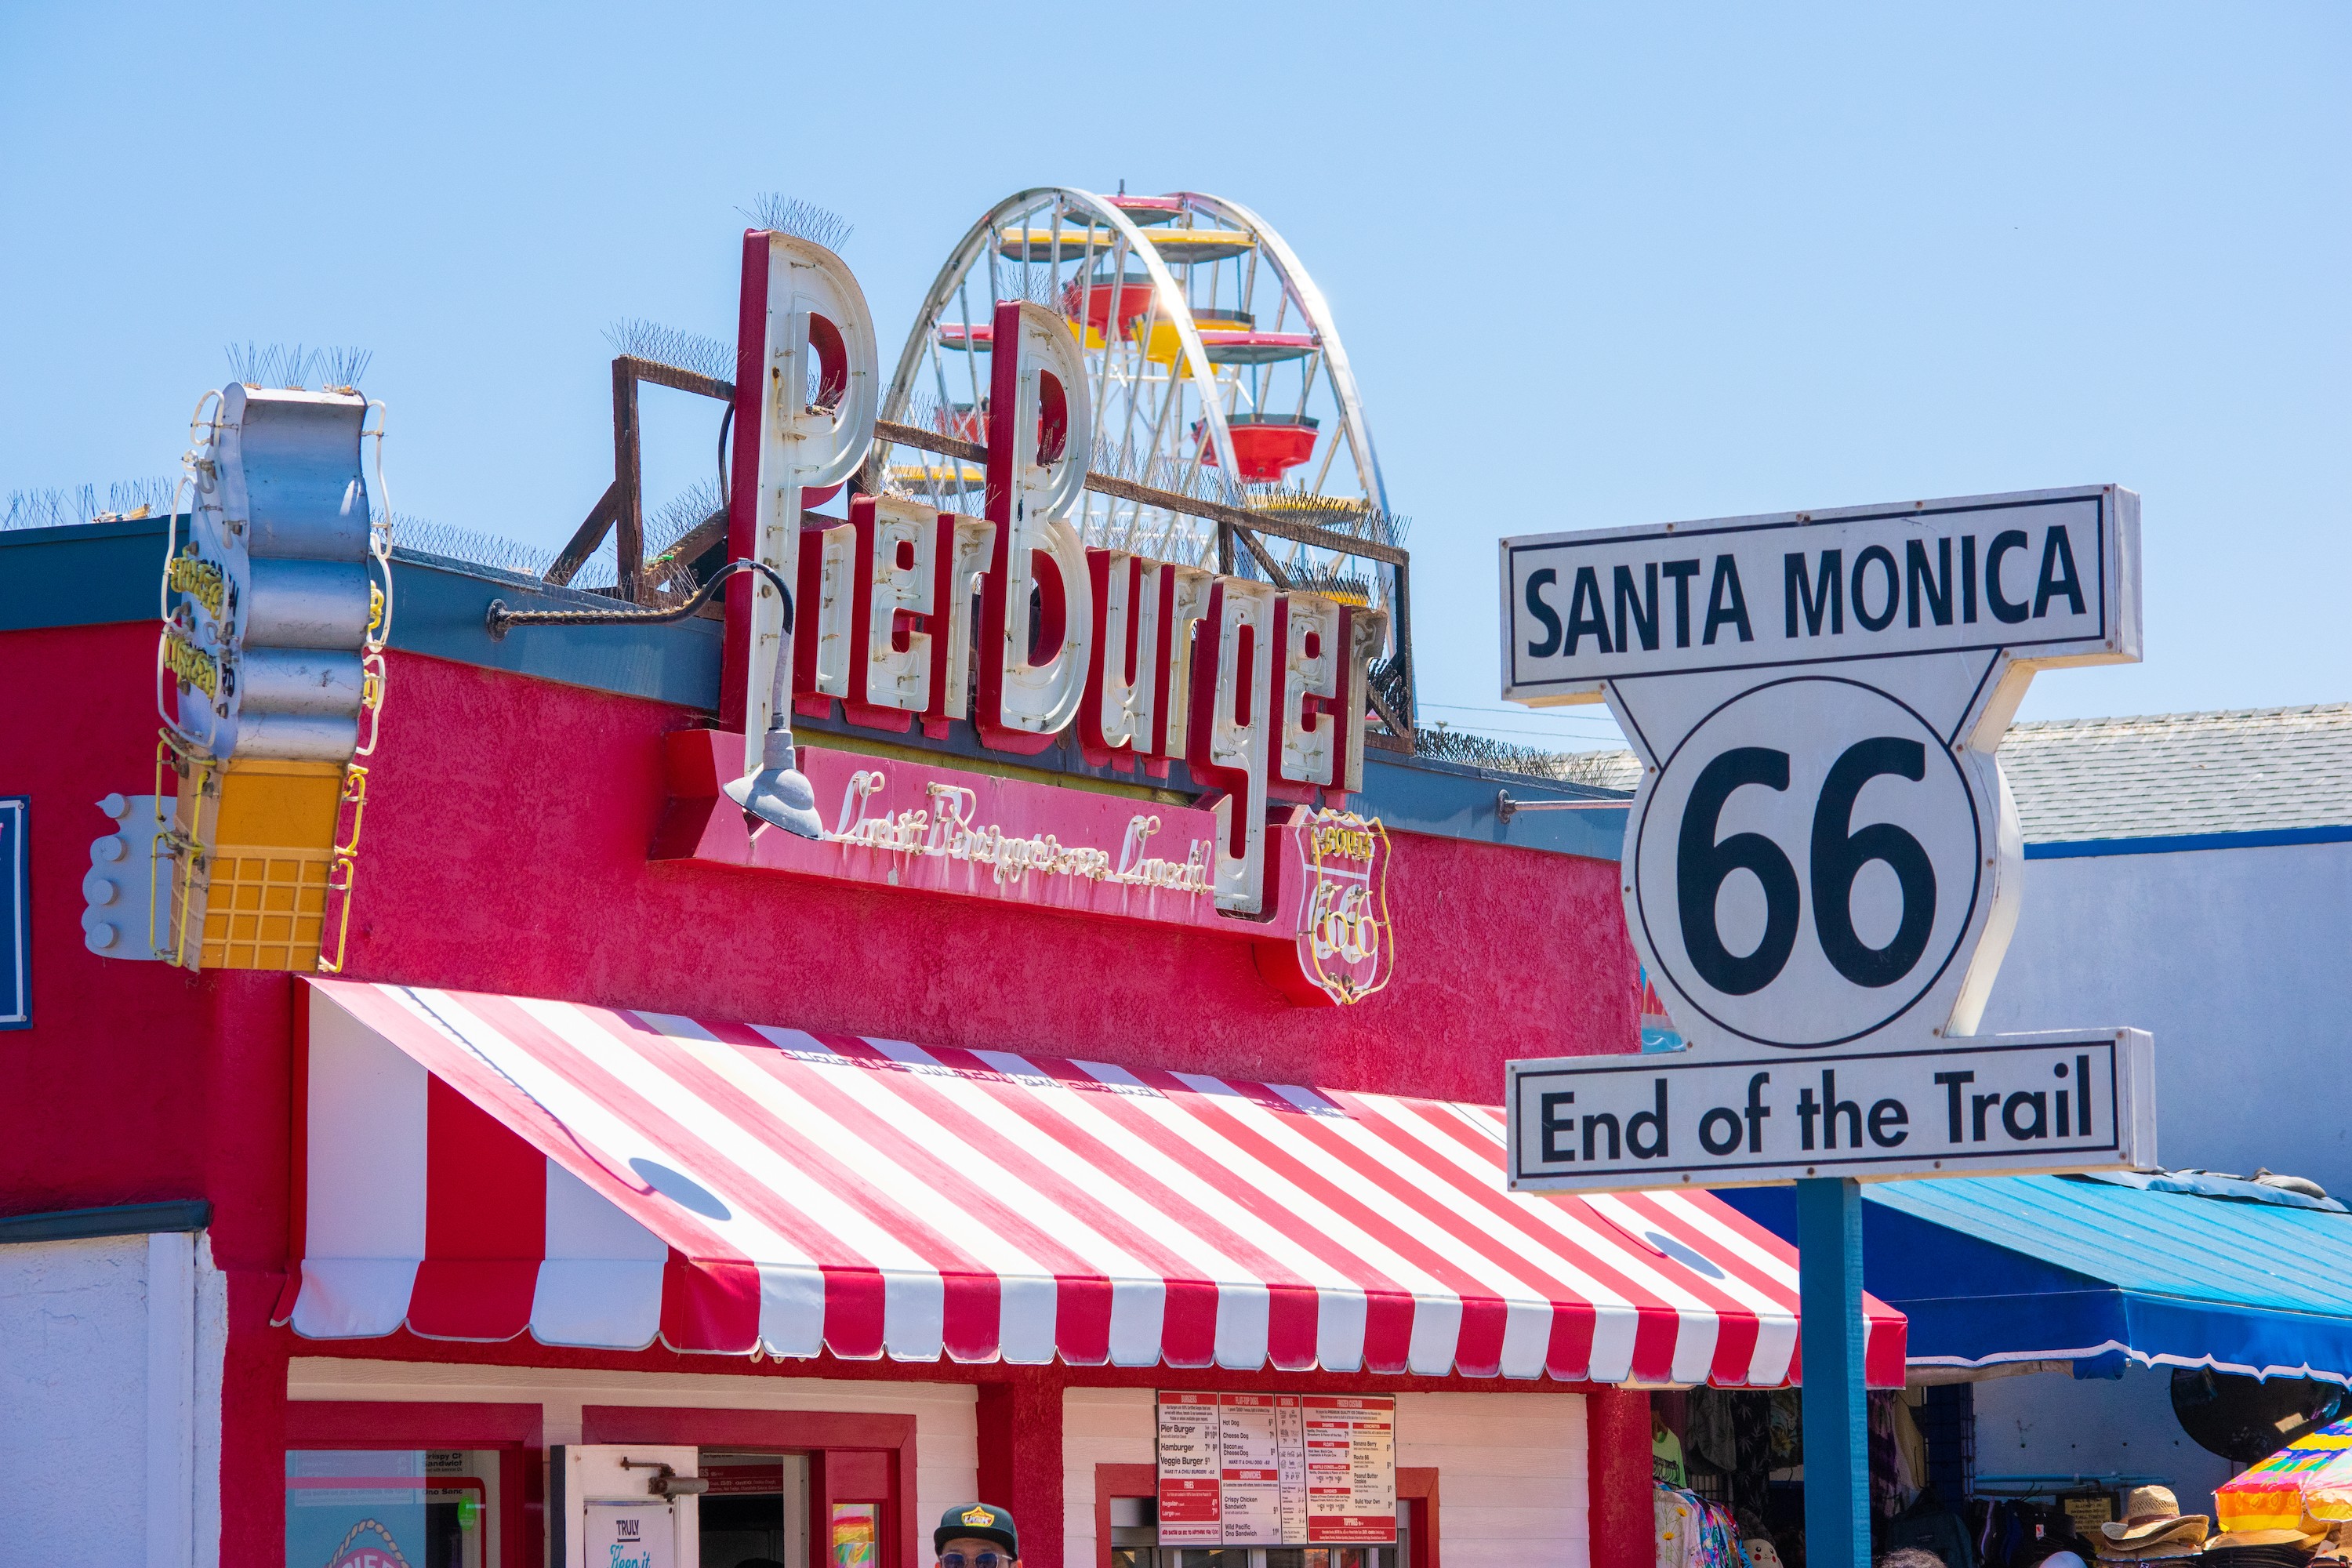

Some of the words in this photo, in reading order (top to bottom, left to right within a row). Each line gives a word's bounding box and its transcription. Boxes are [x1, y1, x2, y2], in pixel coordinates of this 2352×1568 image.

[719, 230, 997, 778] Pier
[977, 301, 1386, 915] Burger
[1525, 554, 1754, 659] SANTA
[1784, 524, 2087, 639] MONICA
[1677, 736, 1937, 996] 66
[1307, 879, 1379, 964] 66
[1541, 1077, 1668, 1163] End
[1698, 1071, 1771, 1155] of
[1797, 1069, 1909, 1150] the
[1934, 1054, 2092, 1144] Trail
[1161, 1443, 1194, 1453] Hamburger
[1174, 1425, 1195, 1434] Burger
[1161, 1457, 1180, 1466] Veggie
[1182, 1457, 1203, 1466] Burger
[616, 1519, 639, 1536] TRULY
[610, 1544, 639, 1568] Keep
[641, 1551, 651, 1568] it
